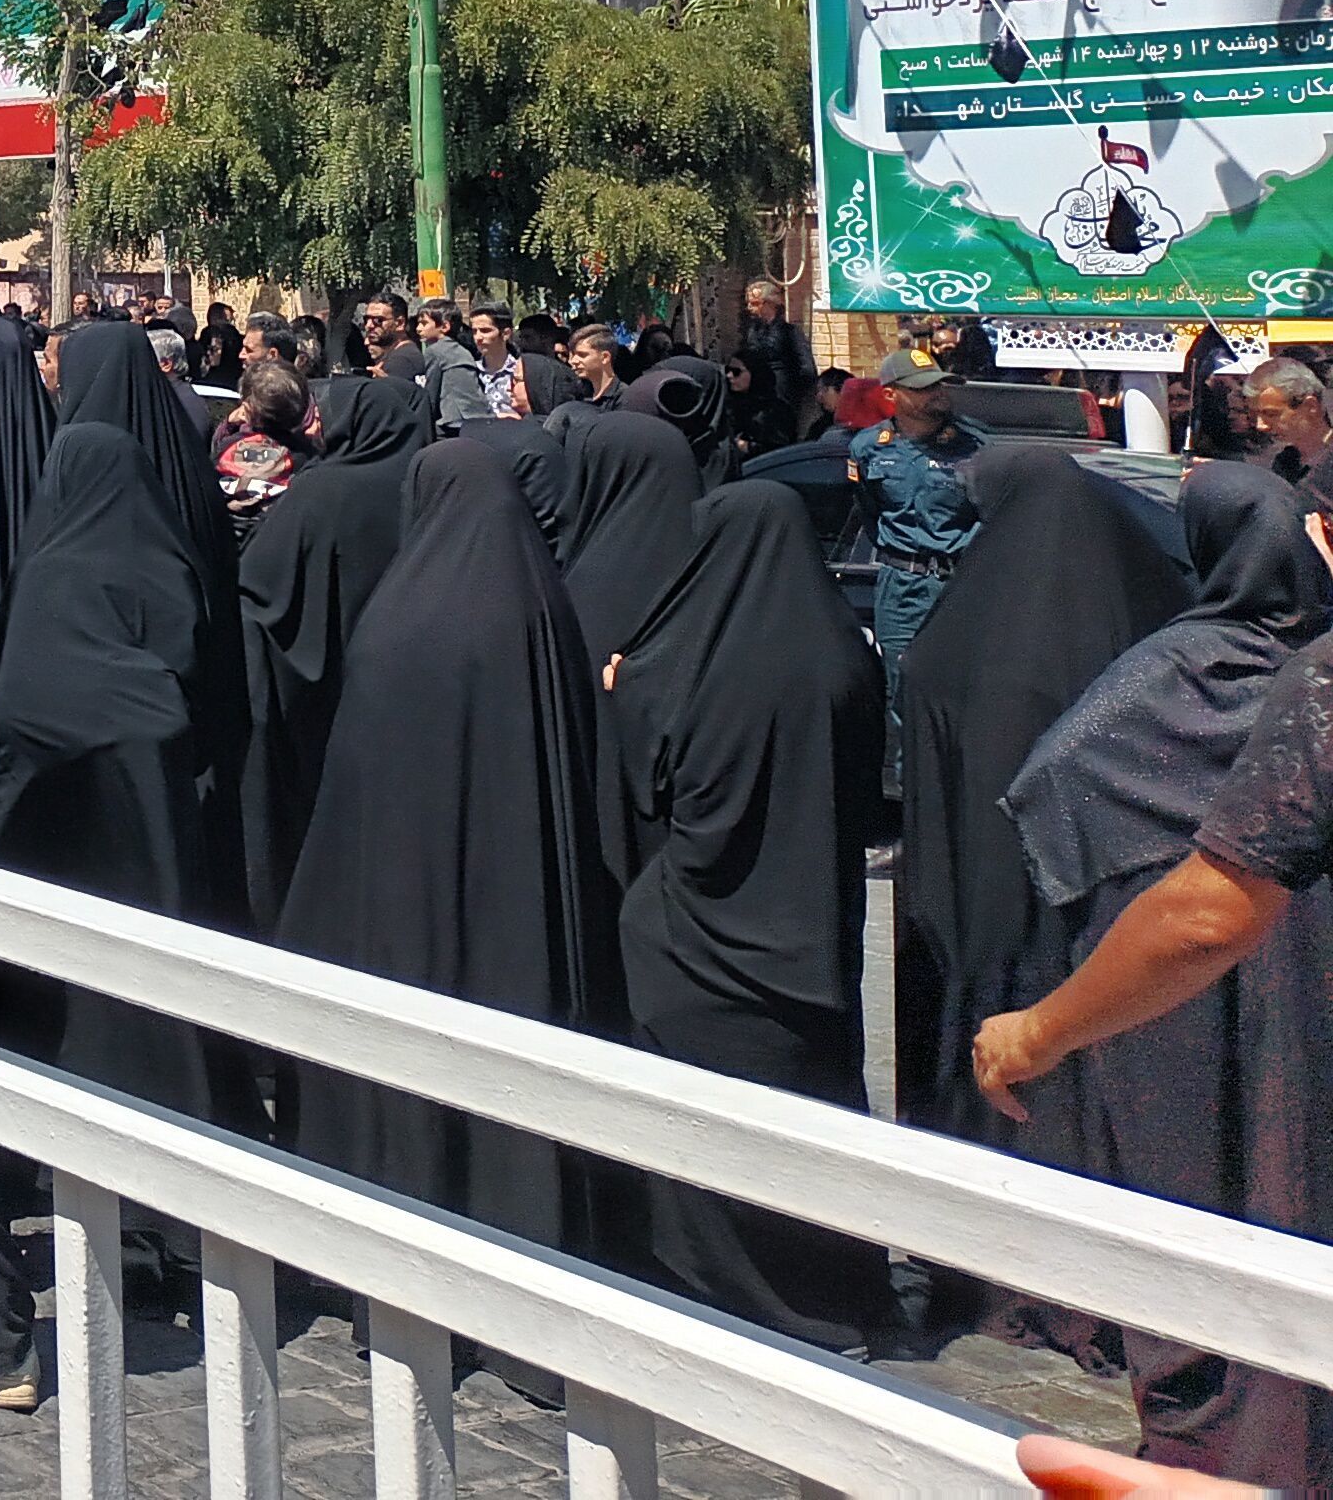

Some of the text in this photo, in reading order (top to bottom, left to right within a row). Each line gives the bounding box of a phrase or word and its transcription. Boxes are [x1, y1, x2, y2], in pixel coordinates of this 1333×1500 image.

[1071, 46, 1091, 64] ۱۴
[1097, 41, 1168, 64] چهارشنبه
[1173, 43, 1181, 60] و
[1191, 38, 1210, 56] ۱۲
[1216, 33, 1278, 56] دوشنبه
[933, 56, 942, 70] ۹
[1024, 46, 1063, 69] شهری
[899, 58, 928, 81] صبح
[990, 90, 1084, 120] گلستان
[1090, 91, 1186, 114] حسینی
[1193, 81, 1265, 106] خیمه
[1091, 286, 1131, 306] اصفهان
[1135, 288, 1162, 307] اسلام
